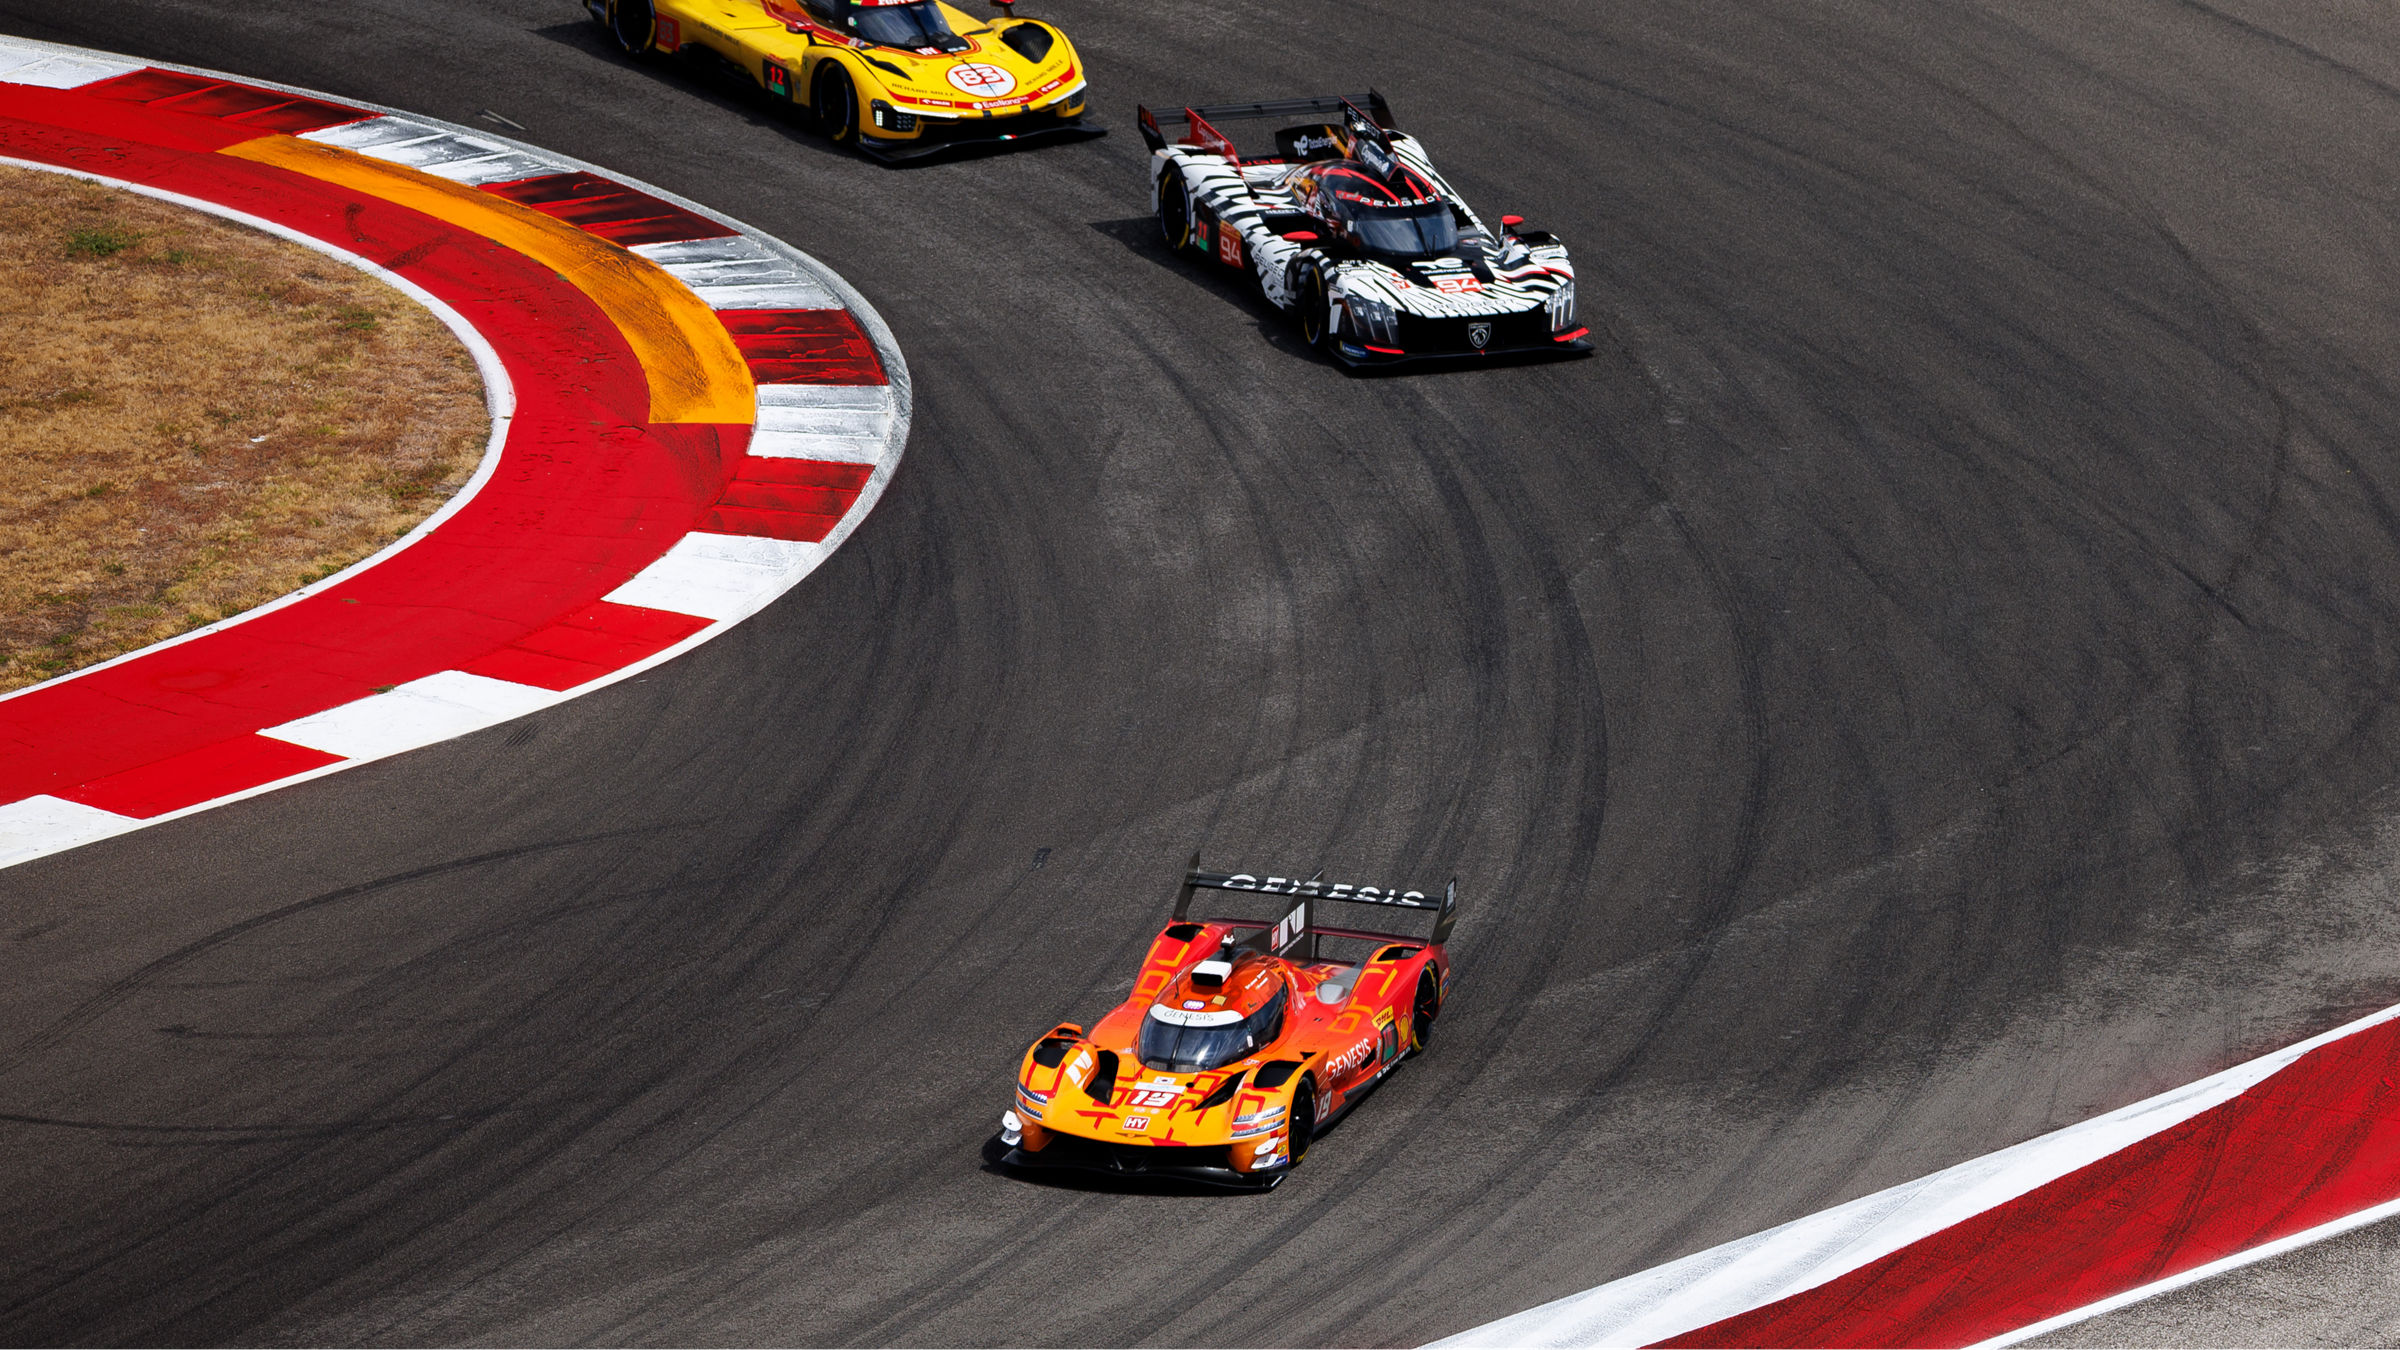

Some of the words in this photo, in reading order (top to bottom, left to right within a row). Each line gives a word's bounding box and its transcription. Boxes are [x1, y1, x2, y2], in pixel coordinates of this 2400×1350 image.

[770, 66, 784, 85] 12
[957, 67, 1000, 84] 83
[1360, 192, 1437, 207] PEUGEOT
[1220, 236, 1242, 266] 94
[1436, 280, 1485, 293] 94
[1164, 1010, 1215, 1022] GENESIS
[1375, 1010, 1393, 1029] DHL
[1325, 1037, 1372, 1081] GENESIS
[1130, 1090, 1176, 1107] 19
[1315, 1090, 1332, 1122] 19
[1125, 1117, 1149, 1130] HY
